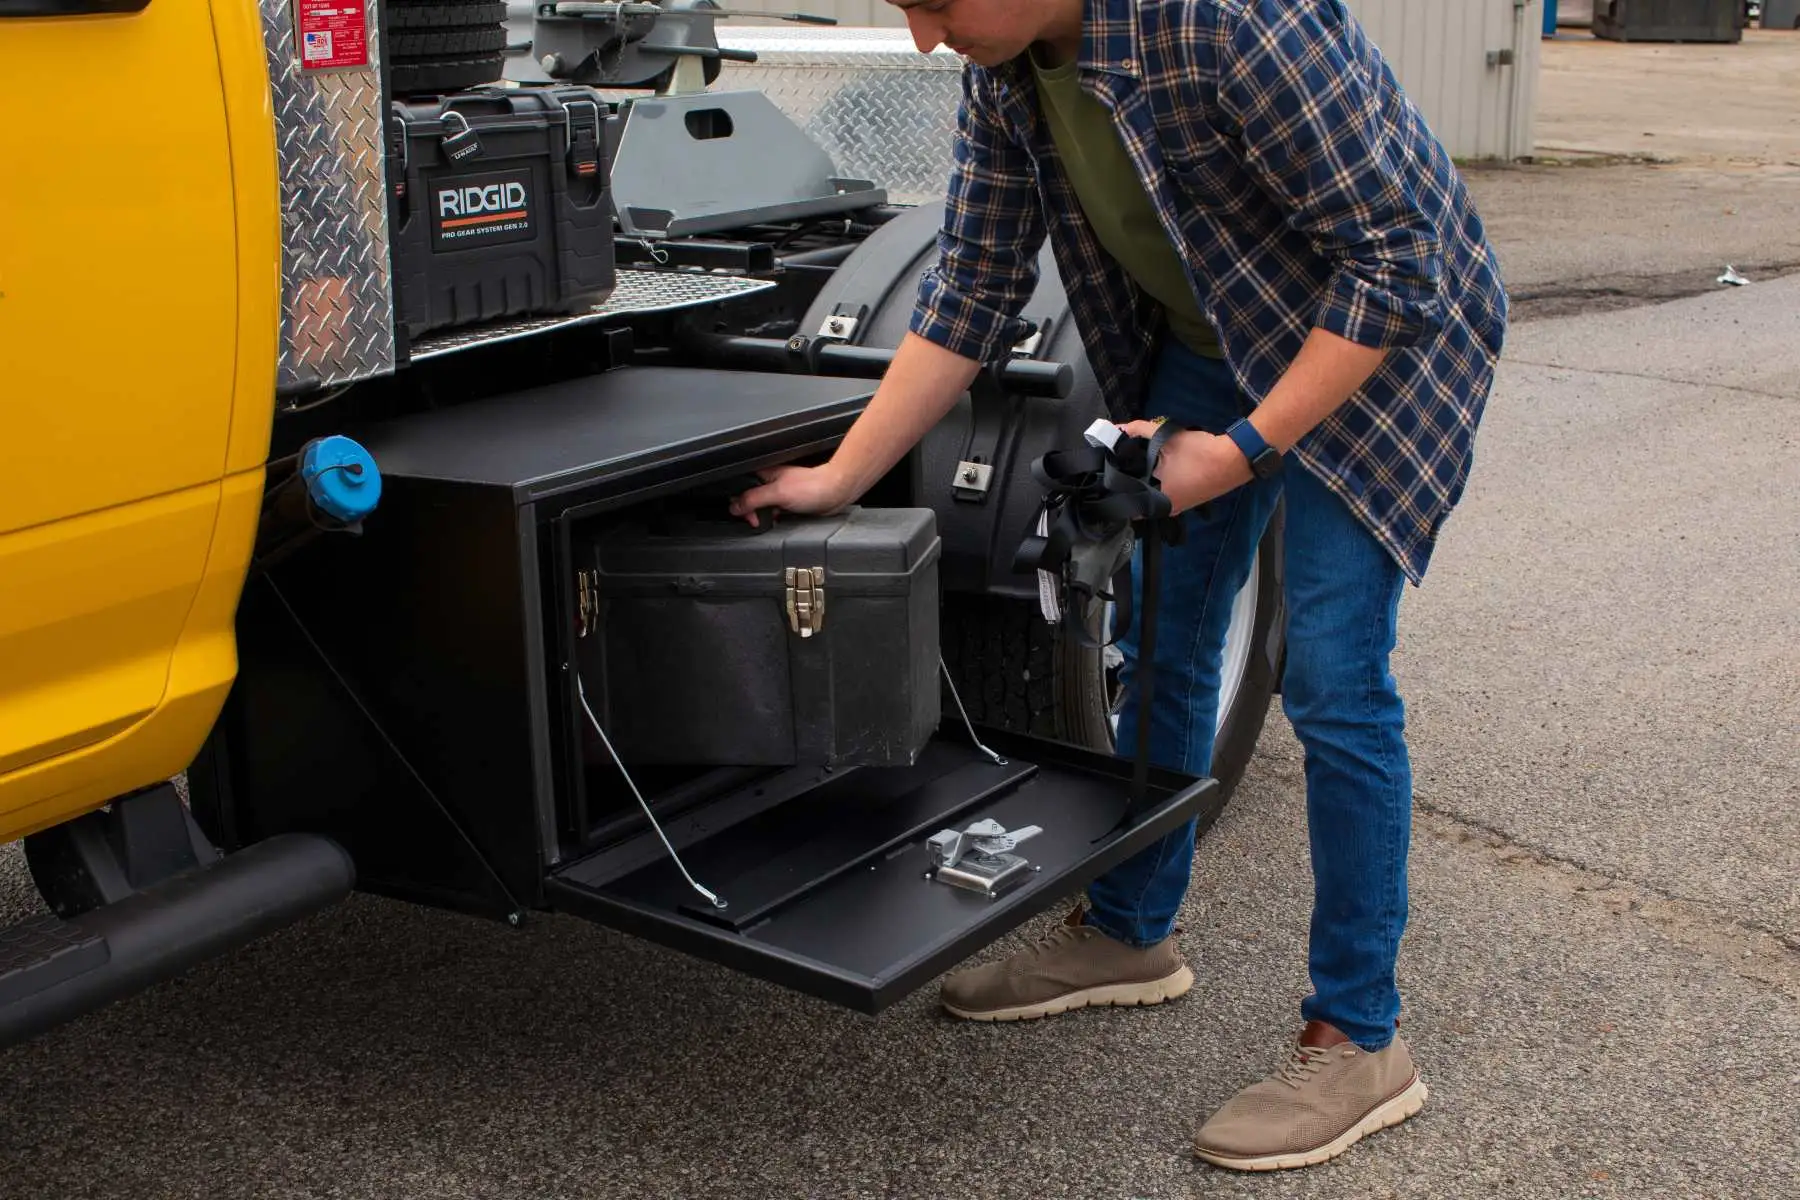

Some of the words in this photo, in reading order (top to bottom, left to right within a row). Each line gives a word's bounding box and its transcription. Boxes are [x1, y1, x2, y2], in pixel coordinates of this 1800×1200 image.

[438, 182, 526, 217] RIDGID
[441, 231, 456, 239] PRO
[456, 229, 475, 237] GEAR
[477, 225, 503, 235] SYSTEM
[503, 223, 518, 231] GEN
